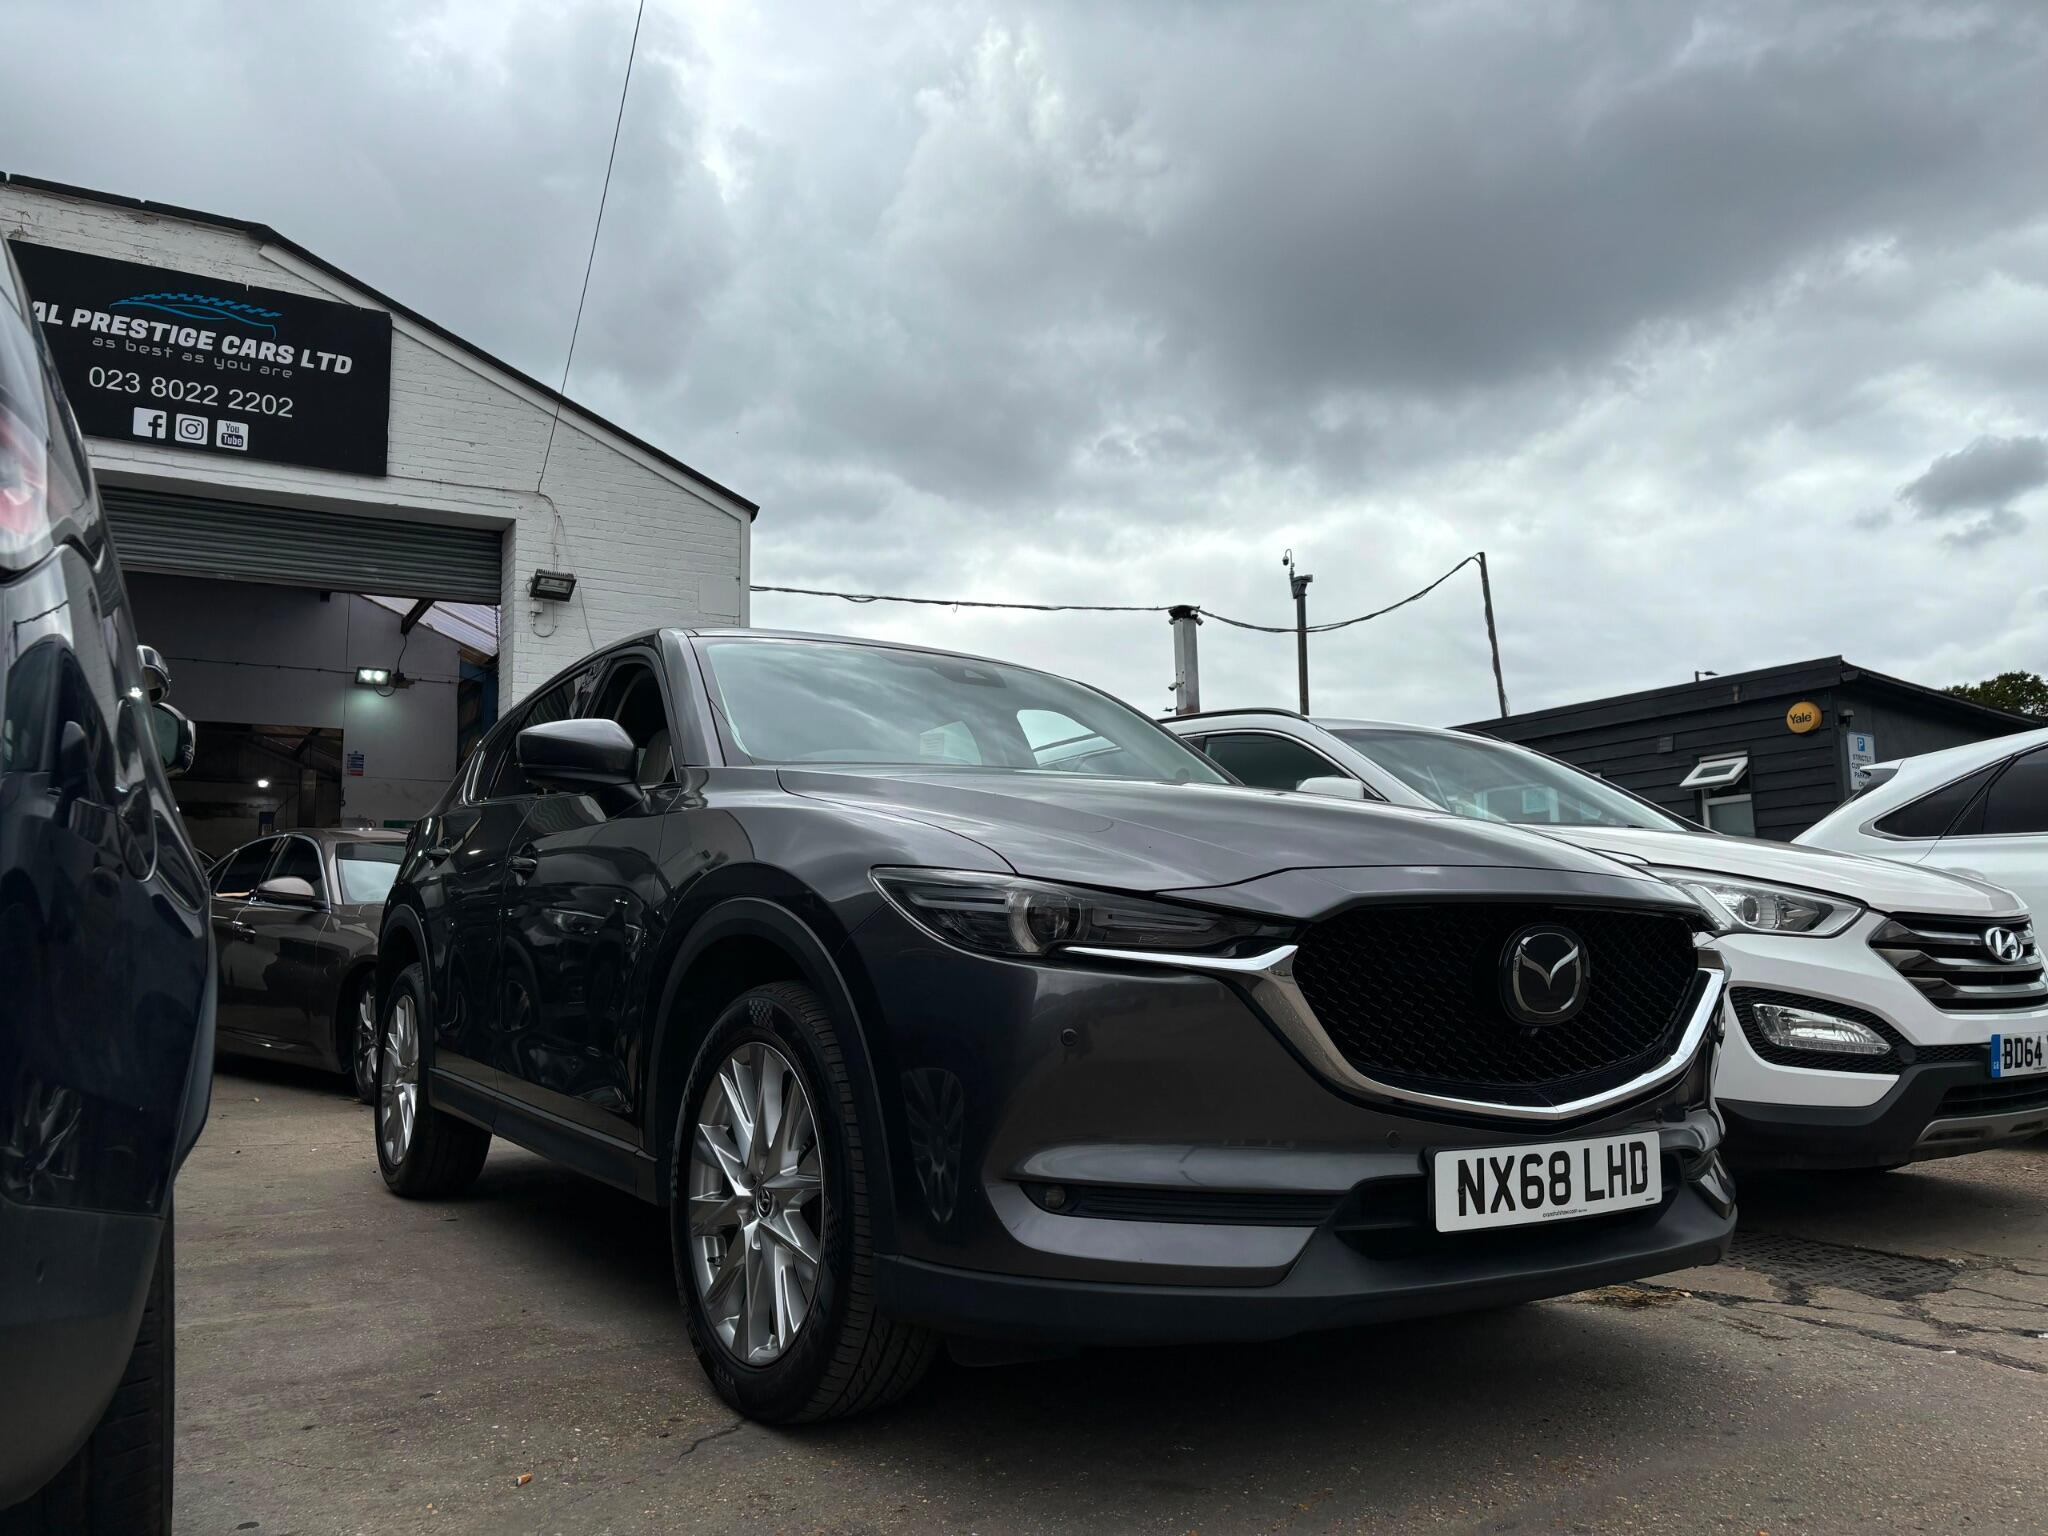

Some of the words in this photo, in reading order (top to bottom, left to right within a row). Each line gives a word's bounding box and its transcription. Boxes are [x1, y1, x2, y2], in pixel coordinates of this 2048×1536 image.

[71, 308, 217, 350] PRESTIGE
[221, 335, 295, 364] CARS
[300, 349, 352, 374] LTD
[92, 337, 116, 349] as
[125, 339, 173, 358] best
[182, 351, 204, 363] as
[214, 357, 250, 371] you
[260, 365, 292, 378] are
[89, 366, 140, 393] 023
[151, 376, 218, 406] 8022
[228, 389, 293, 418] 2202
[223, 434, 243, 446] Tube
[225, 422, 240, 434] You
[1789, 712, 1812, 724] Yale
[2003, 1036, 2043, 1070] BD64
[1457, 1150, 1572, 1217] NX68
[1583, 1140, 1648, 1202] LHD
